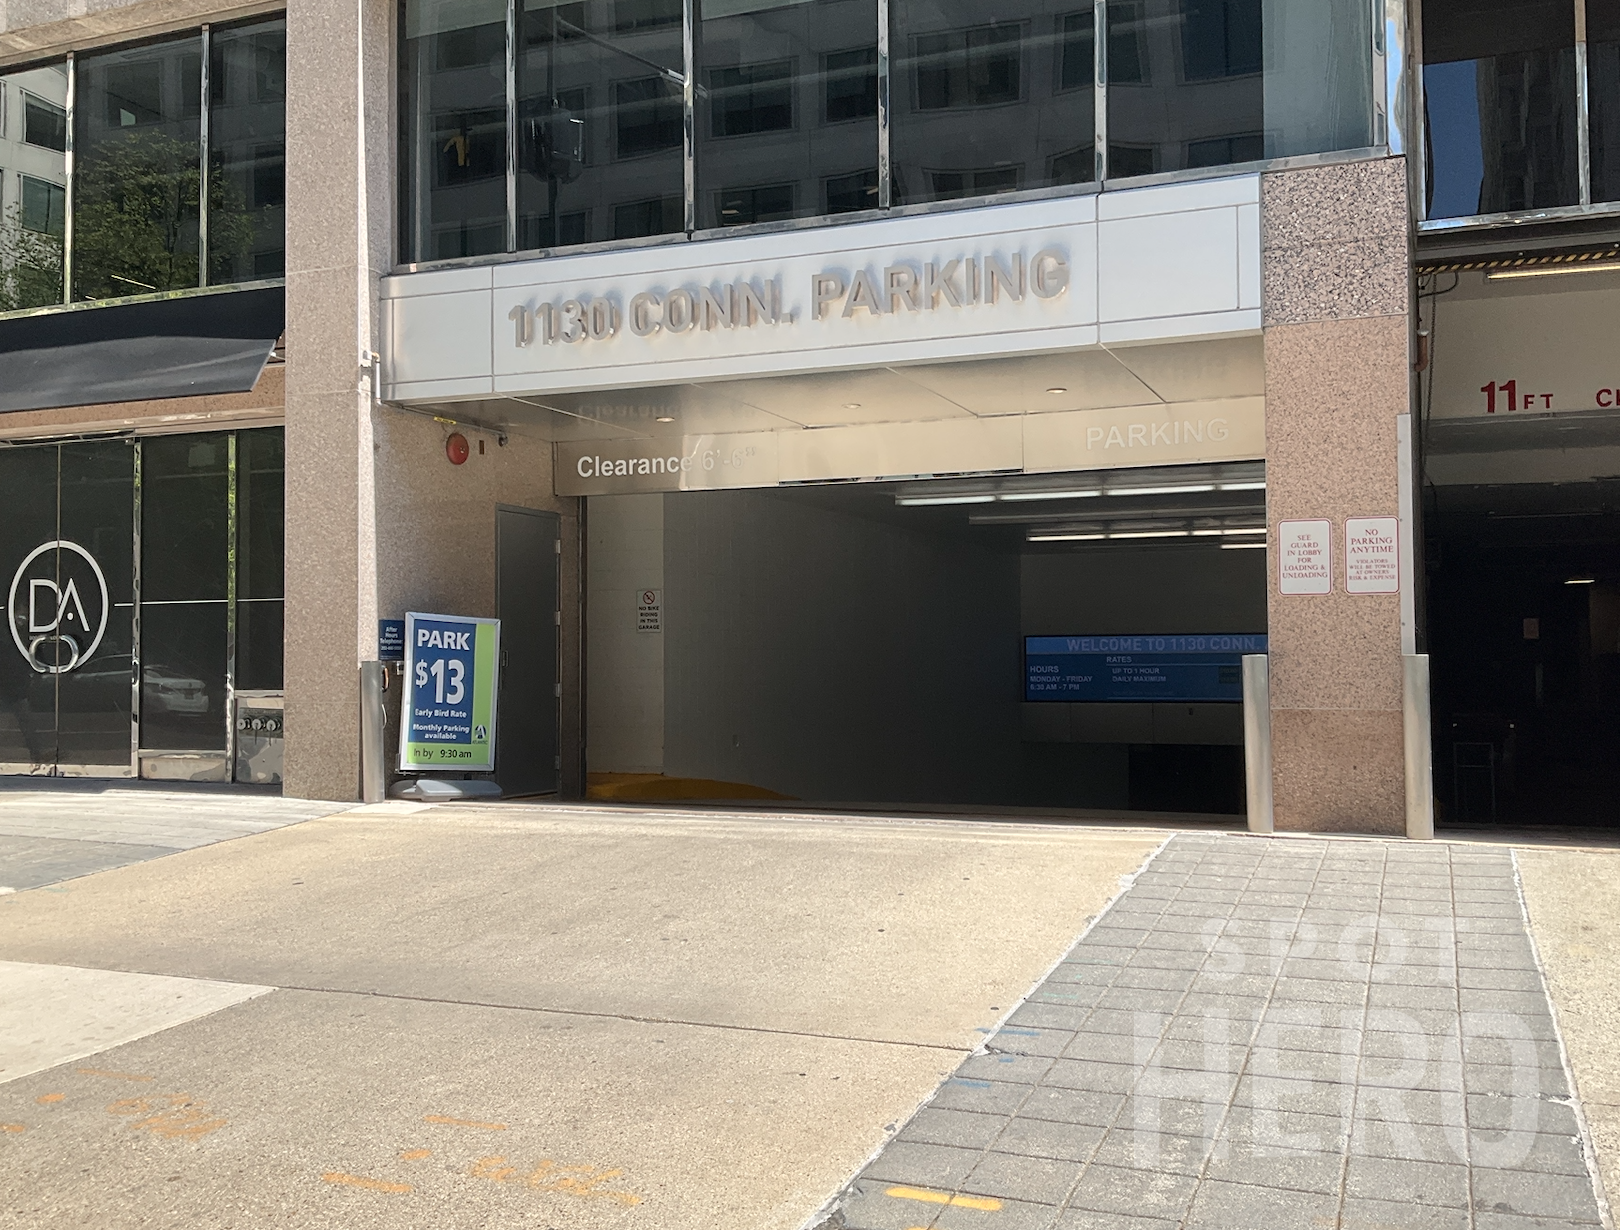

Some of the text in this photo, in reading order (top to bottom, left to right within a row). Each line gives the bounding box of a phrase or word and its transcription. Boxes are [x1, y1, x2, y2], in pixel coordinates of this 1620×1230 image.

[508, 250, 1071, 348] 1130 CONN. PARKING
[1480, 379, 1517, 413] 11
[1523, 393, 1554, 410] FT
[1086, 417, 1230, 450] PARKING
[577, 454, 694, 478] Clearance
[1364, 528, 1379, 536] NO
[1350, 536, 1393, 545] PARKING
[1349, 545, 1394, 554] ANYTIME
[417, 628, 471, 651] PARK
[1066, 638, 1142, 652] WELCOME
[1145, 638, 1165, 651] TO
[1170, 637, 1206, 651] 1130
[1209, 637, 1261, 650] CONN.
[1029, 665, 1060, 673] HOURS
[415, 659, 465, 706] $13
[1111, 675, 1132, 683] DAILY
[1045, 683, 1057, 691] AM
[1062, 683, 1067, 691] 7
[1068, 683, 1080, 691] PM
[414, 708, 467, 718] Early Bird Rate
[413, 723, 470, 734] Monthly Parking
[424, 732, 457, 740] available
[413, 748, 472, 759] In by 9:30 am
